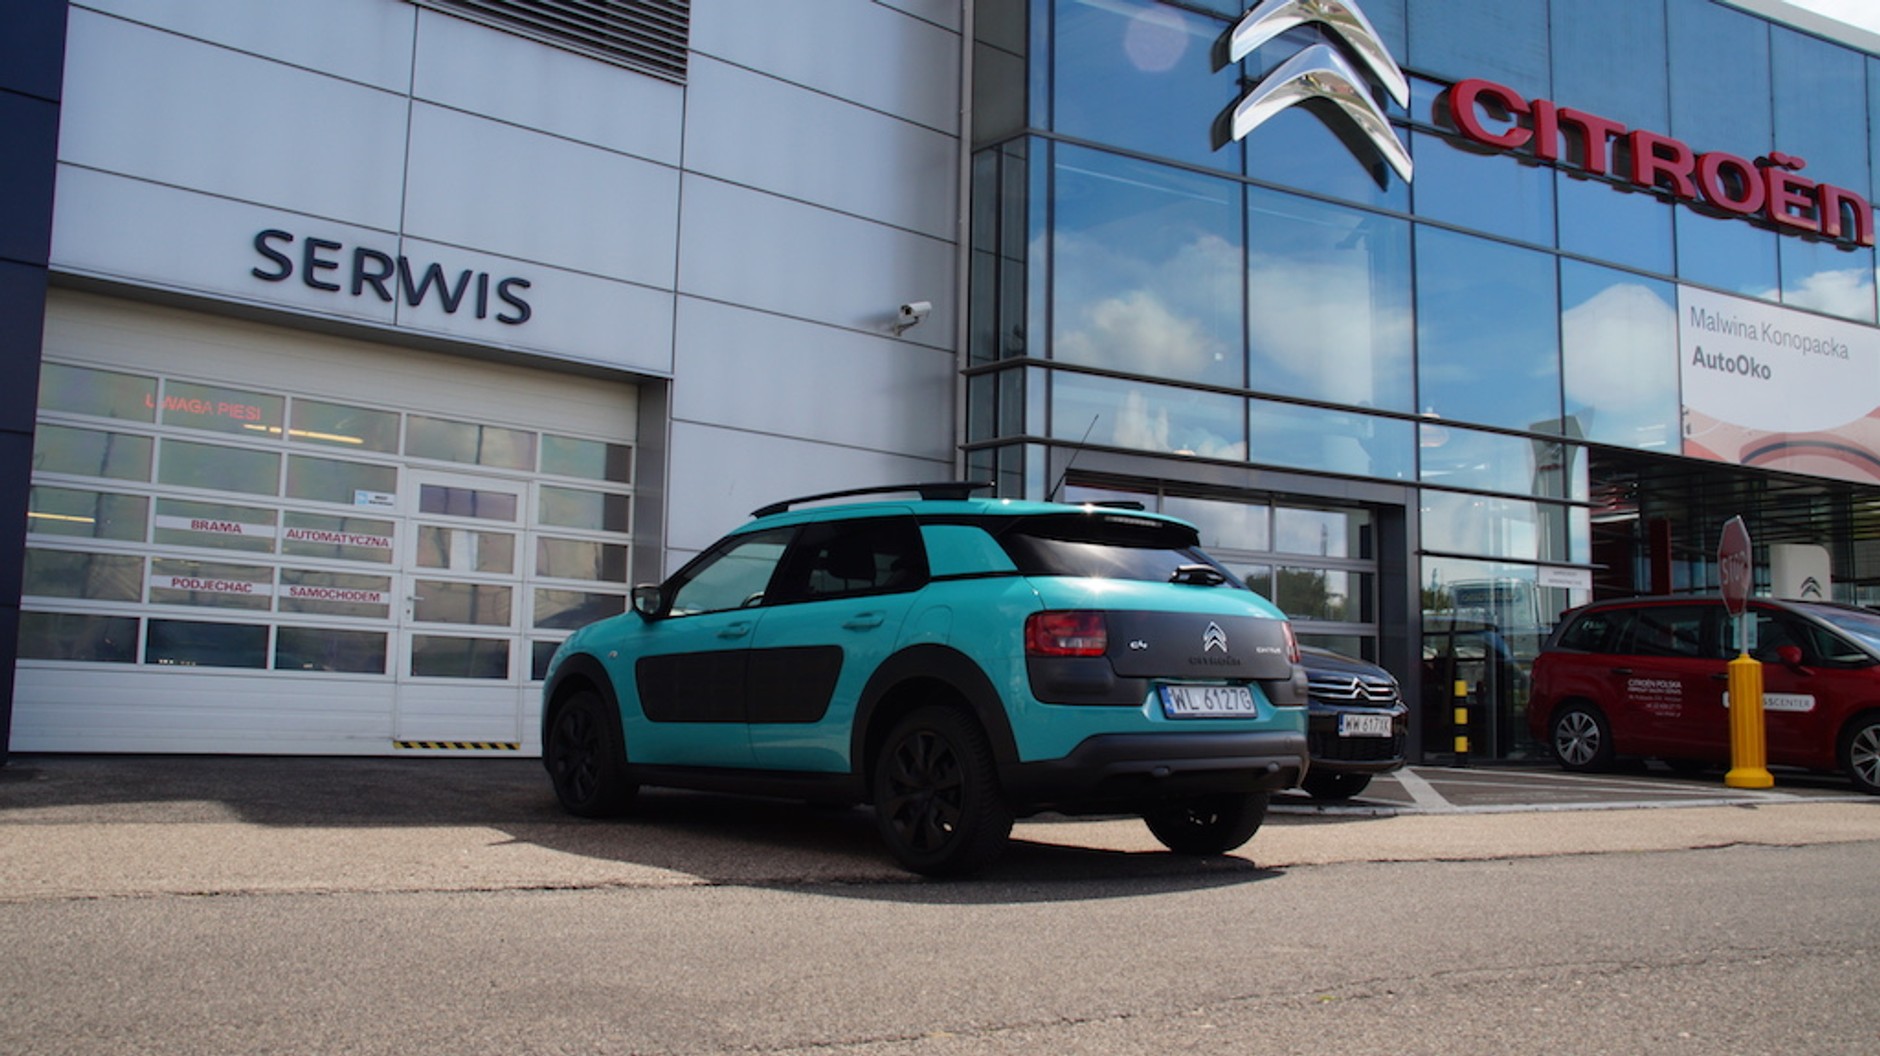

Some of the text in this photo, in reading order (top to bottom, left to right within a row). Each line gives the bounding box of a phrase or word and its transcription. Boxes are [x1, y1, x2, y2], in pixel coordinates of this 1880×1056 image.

[251, 229, 532, 325] SERWIS
[1690, 306, 1849, 360] Malwina Konopacka
[1692, 346, 1772, 380] AutoOko
[217, 402, 261, 421] PIESI
[191, 519, 242, 534] BRAMA
[286, 528, 390, 548] AUTOMATYCZNA
[289, 586, 381, 603] SAMOCHODEM
[1171, 688, 1251, 711] WL 6127G
